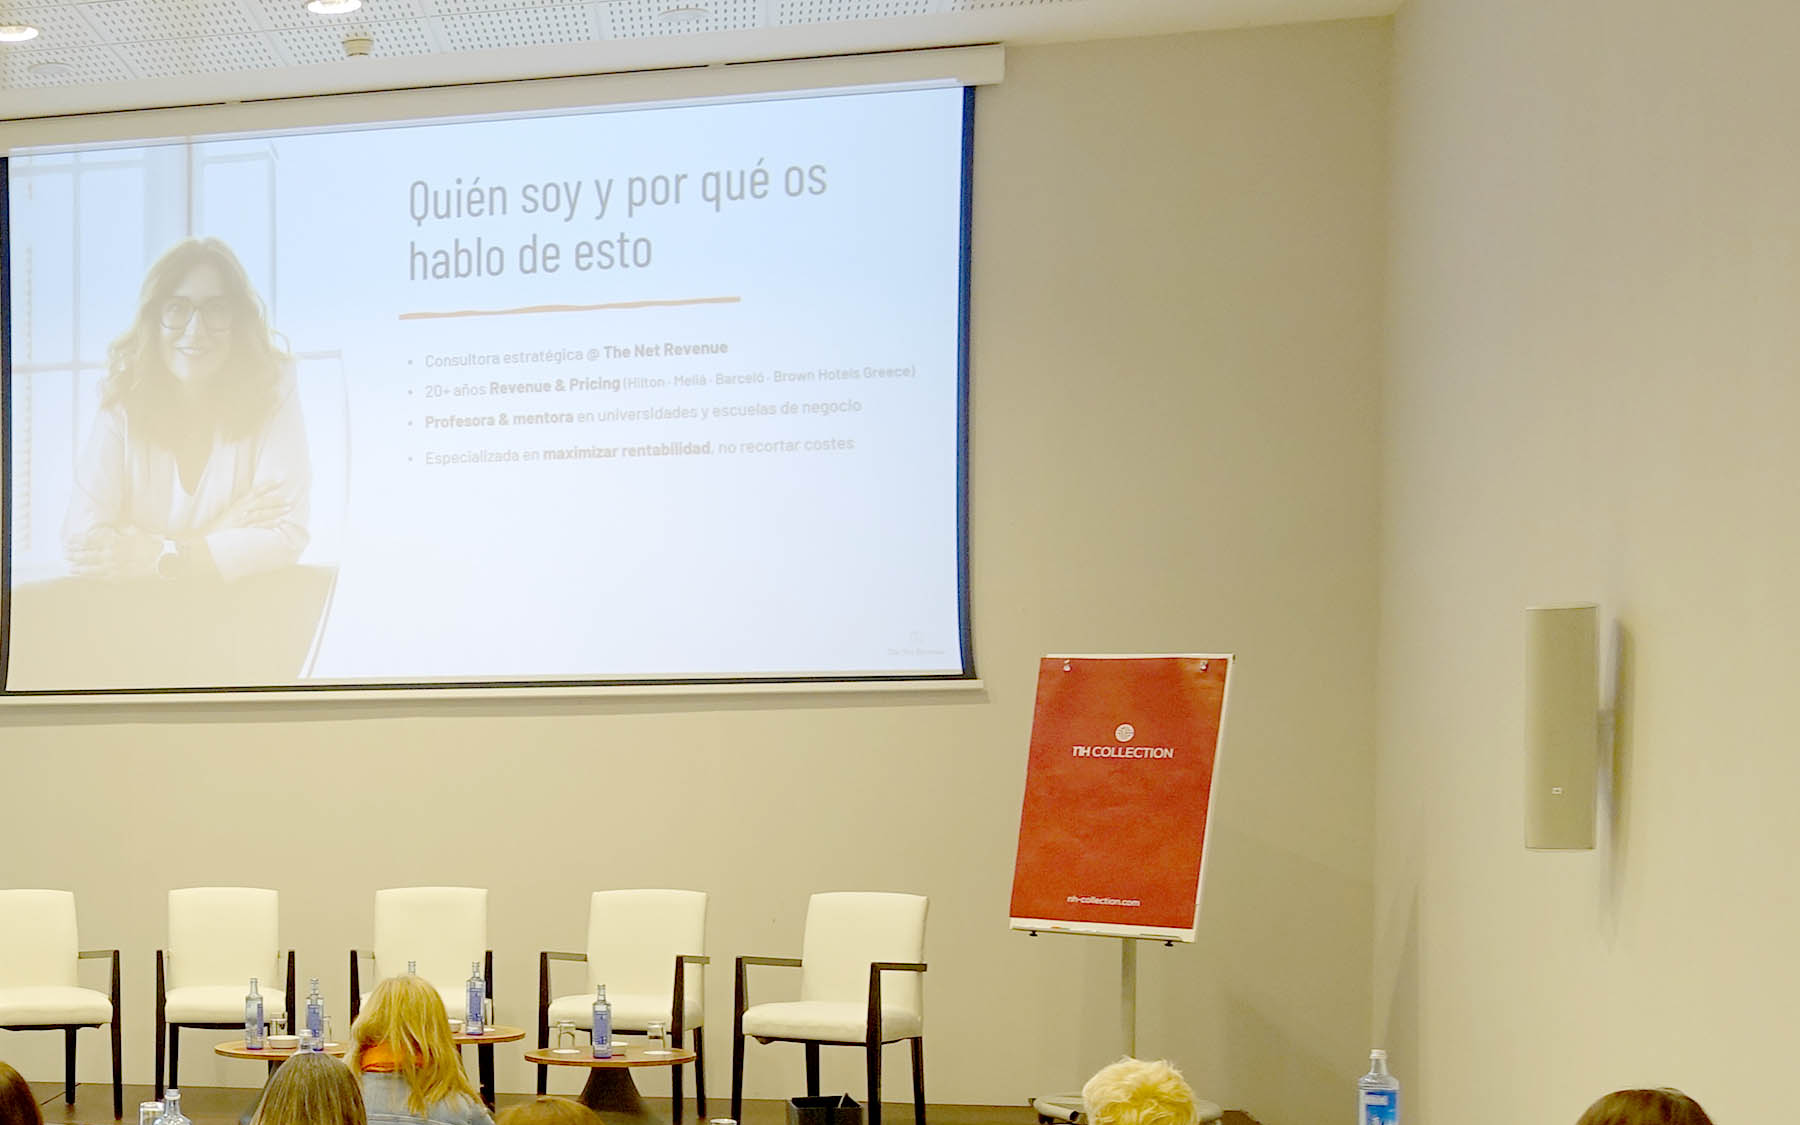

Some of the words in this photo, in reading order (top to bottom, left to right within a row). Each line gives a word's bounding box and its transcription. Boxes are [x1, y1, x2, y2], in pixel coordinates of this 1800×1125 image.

[409, 177, 507, 226] Quién
[521, 179, 582, 222] soy
[594, 178, 613, 220] y
[627, 172, 688, 218] por
[701, 158, 769, 213] qué
[784, 164, 827, 196] os
[409, 237, 504, 281] hablo
[518, 233, 560, 275] de
[574, 232, 651, 271] esto
[425, 353, 500, 368] Consultora
[503, 348, 584, 365] estratégica
[603, 345, 631, 359] The
[634, 344, 660, 357] Net
[664, 342, 728, 357] Revenue
[425, 385, 451, 398] 20+
[453, 383, 487, 397] años
[489, 381, 551, 395] Revenue
[555, 379, 567, 391] &
[569, 377, 621, 392] Pricing
[774, 370, 815, 383] Brown
[818, 368, 861, 381] Hotels
[425, 414, 495, 429] Profesora
[498, 412, 510, 426] &
[513, 411, 573, 425] mentora
[577, 411, 595, 422] en
[598, 404, 698, 422] universidades
[701, 407, 709, 420] y
[712, 402, 777, 417] escuelas
[780, 400, 798, 414] de
[802, 398, 863, 416] negocio
[425, 449, 520, 467] Especializada
[523, 450, 540, 461] en
[543, 444, 618, 460] maximizar
[718, 443, 737, 454] no
[740, 438, 802, 453] recortar
[804, 436, 855, 451] costes
[1092, 746, 1174, 759] COLLECTION
